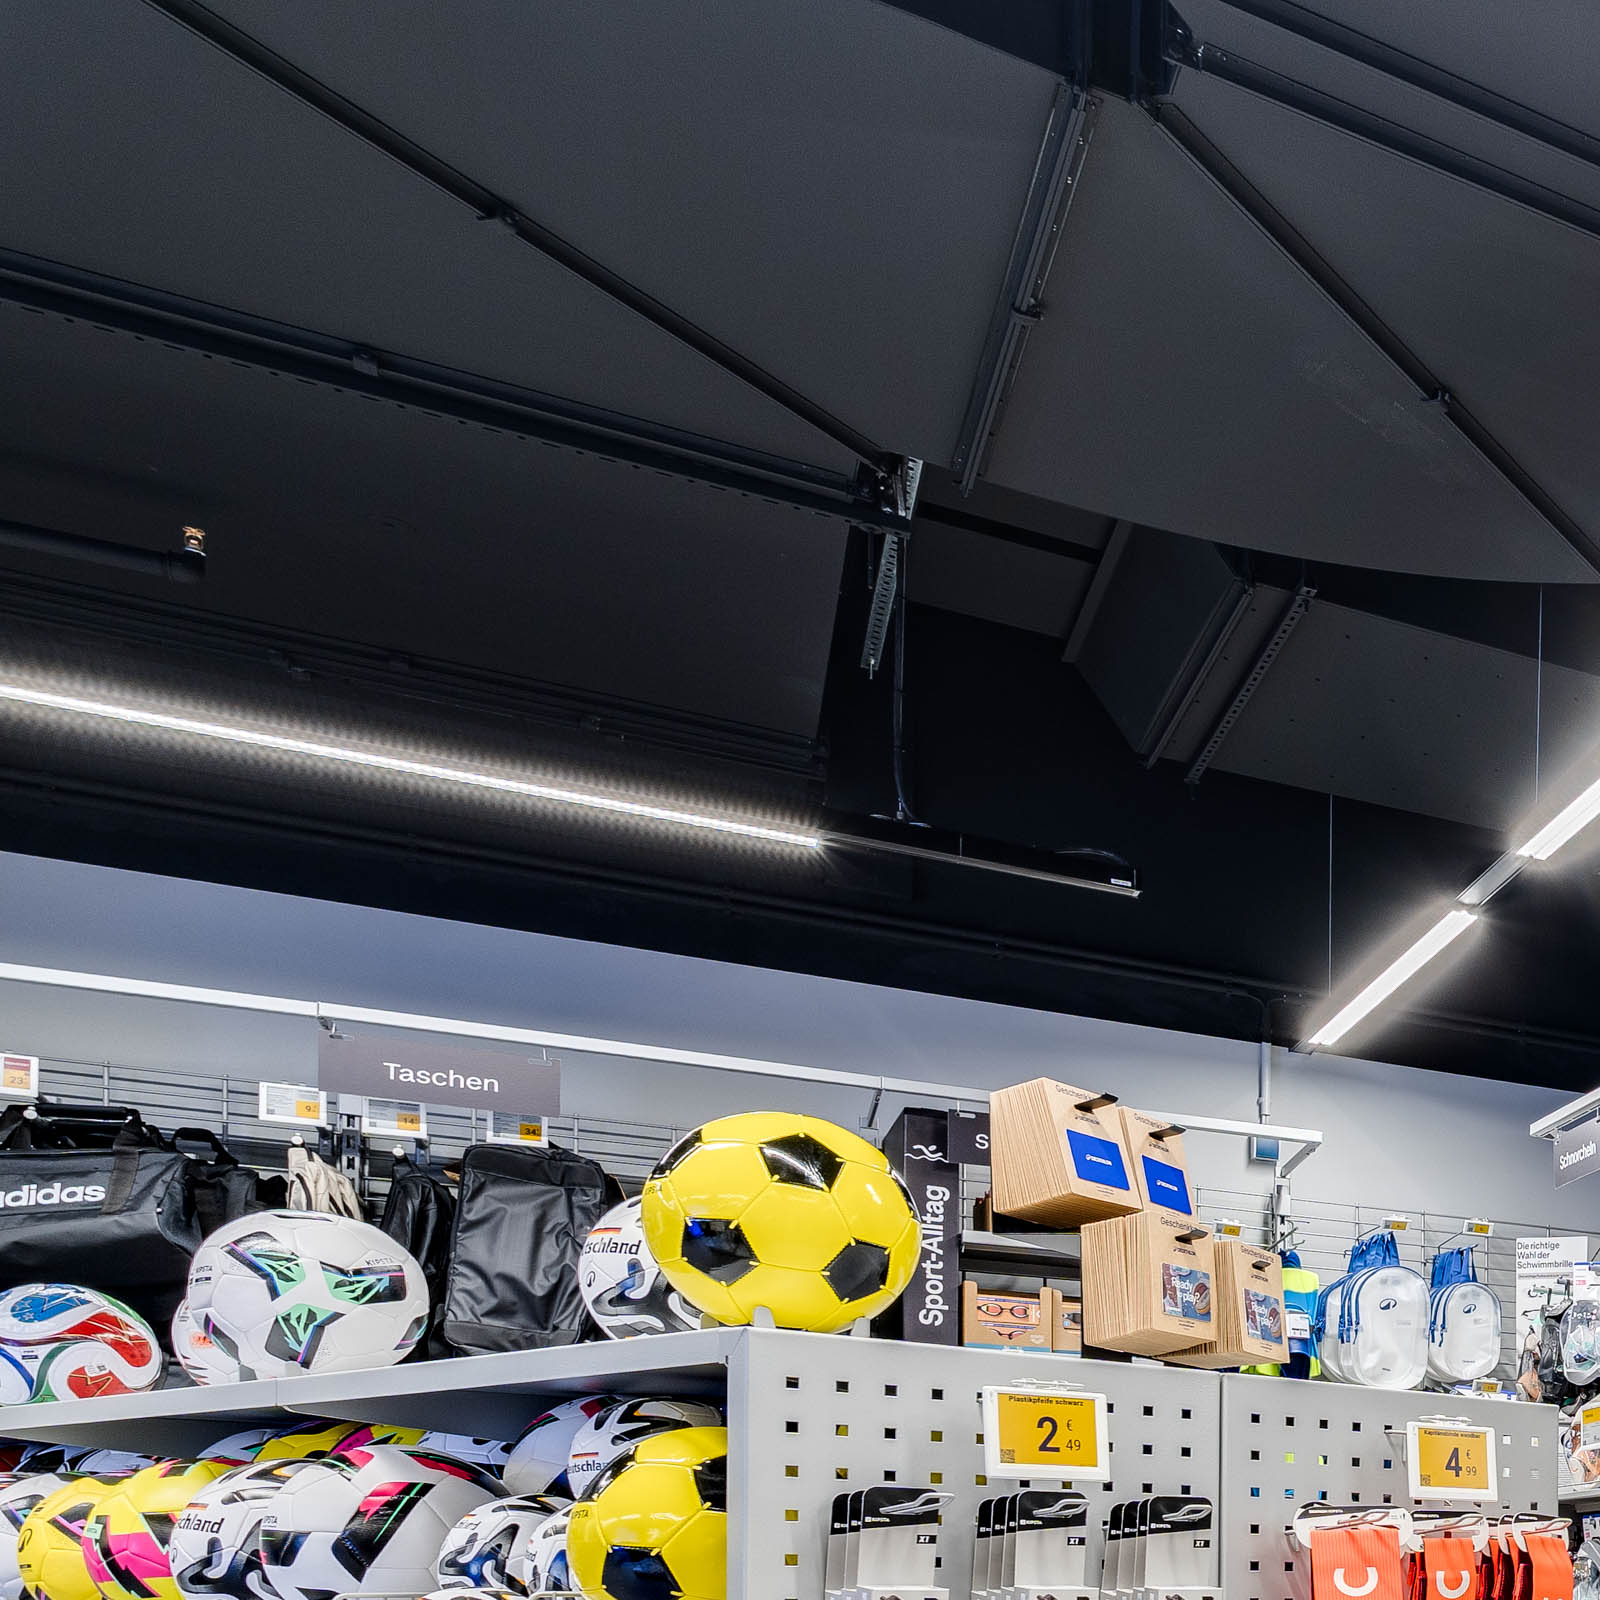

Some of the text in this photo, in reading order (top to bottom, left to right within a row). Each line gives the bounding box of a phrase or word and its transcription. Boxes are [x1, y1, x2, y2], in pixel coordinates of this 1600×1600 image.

[383, 1062, 500, 1093] Taschen
[1559, 1139, 1597, 1172] Schnorcheln
[918, 1184, 951, 1327] Sport-Alltag
[1517, 1240, 1560, 1251] Die richtige
[1517, 1250, 1550, 1260] Wahl der
[1517, 1259, 1573, 1270] Schwimmbrille
[1007, 1394, 1085, 1407] Plastikpfeife schwarz
[1036, 1415, 1061, 1453] 2
[1065, 1439, 1081, 1452] 49
[1445, 1447, 1463, 1478] 4
[1466, 1465, 1478, 1477] 99
